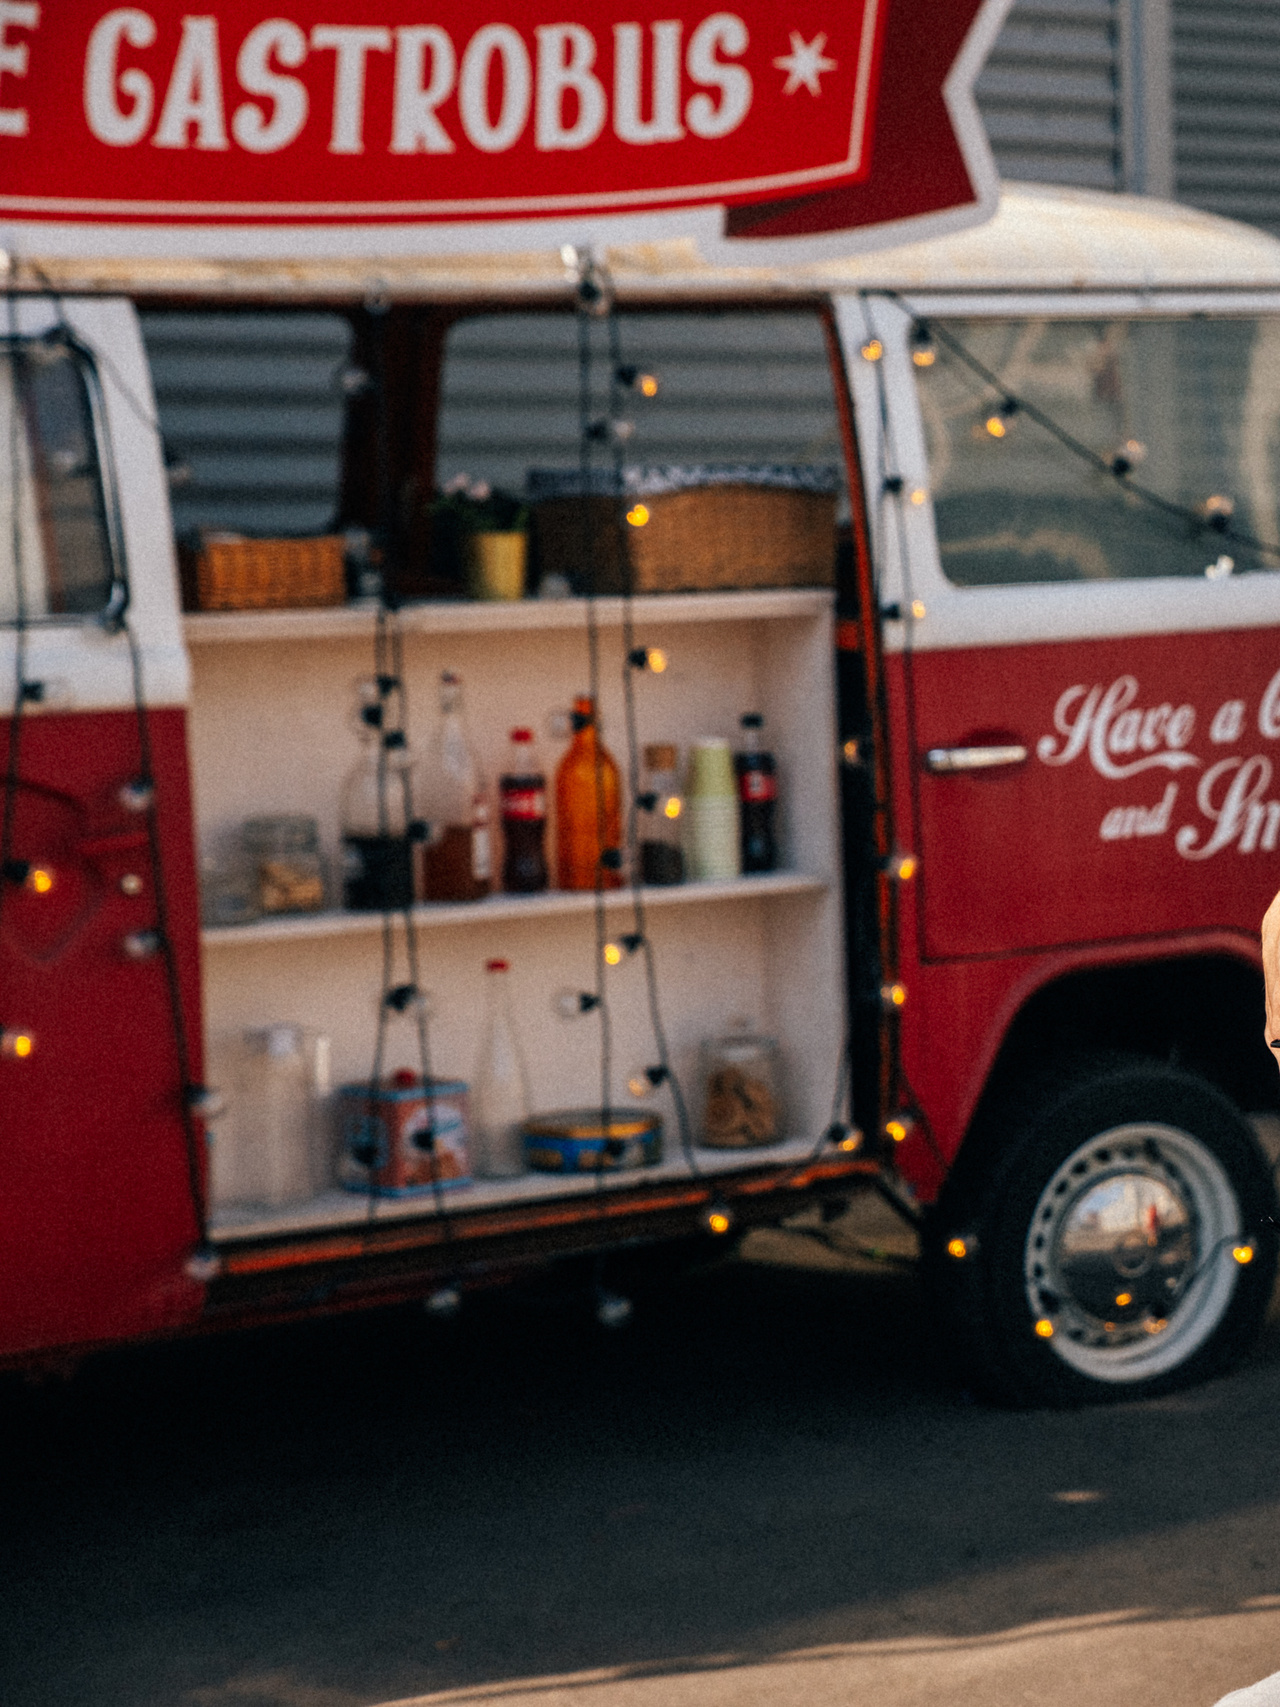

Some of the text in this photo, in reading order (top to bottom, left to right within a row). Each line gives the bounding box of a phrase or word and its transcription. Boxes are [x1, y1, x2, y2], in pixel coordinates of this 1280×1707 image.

[83, 8, 754, 154] GASTROBUS
[1036, 674, 1200, 780] Have
[1209, 699, 1247, 745] a
[1099, 780, 1180, 841] and
